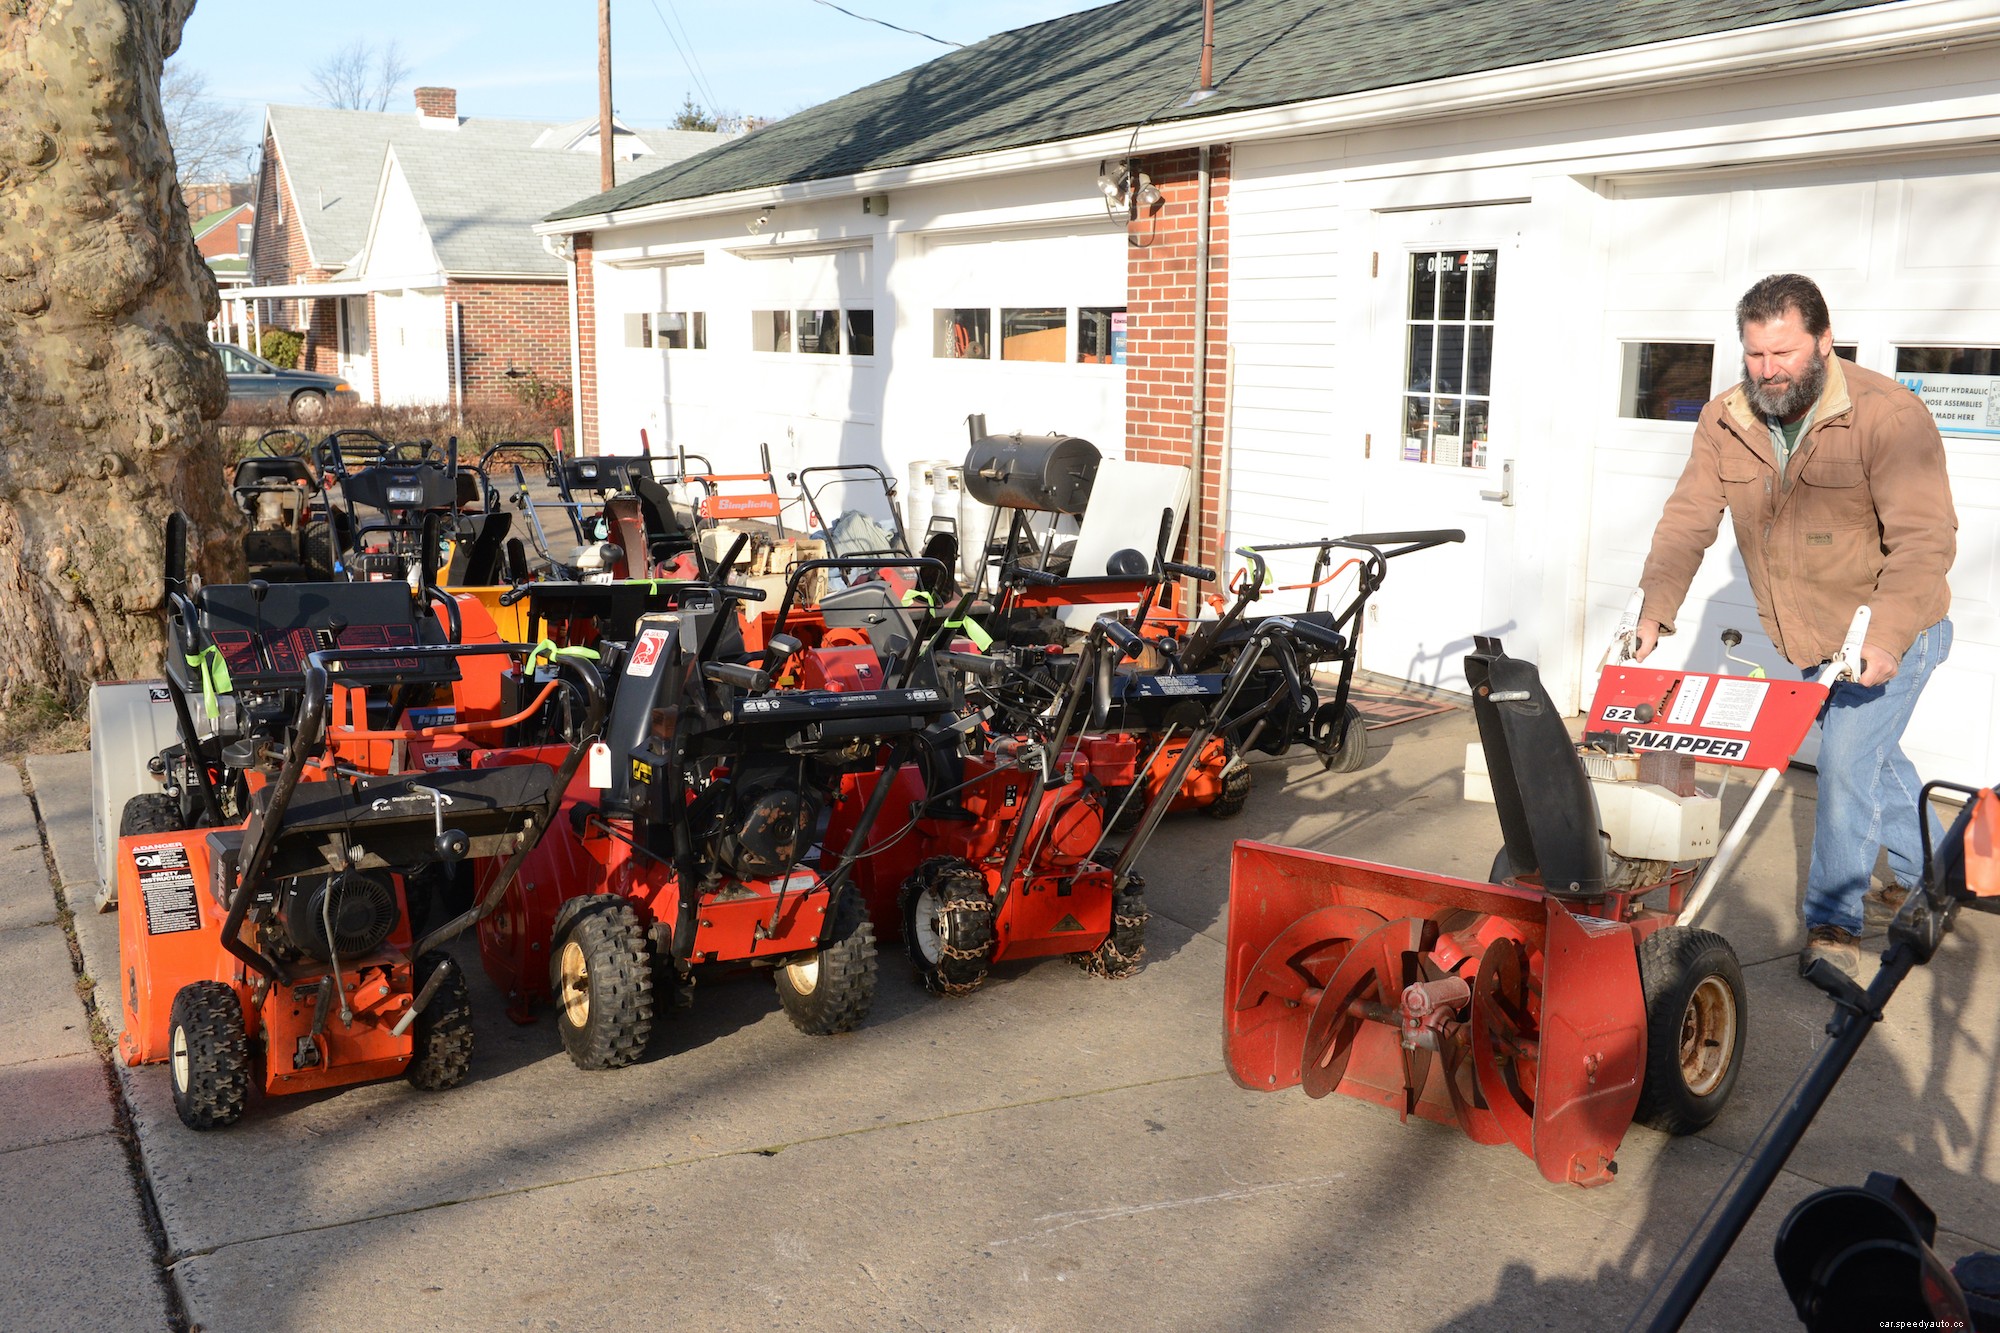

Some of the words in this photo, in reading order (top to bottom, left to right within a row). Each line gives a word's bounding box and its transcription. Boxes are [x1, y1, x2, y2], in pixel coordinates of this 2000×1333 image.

[1951, 387, 1988, 395] HYDRAULIC
[1944, 400, 1982, 408] ASSEMBLIES
[718, 499, 773, 511] Simplicity
[1626, 730, 1744, 758] SNAPPER
[139, 842, 183, 851] DANGER
[140, 873, 192, 883] INSTRUCTIONS
